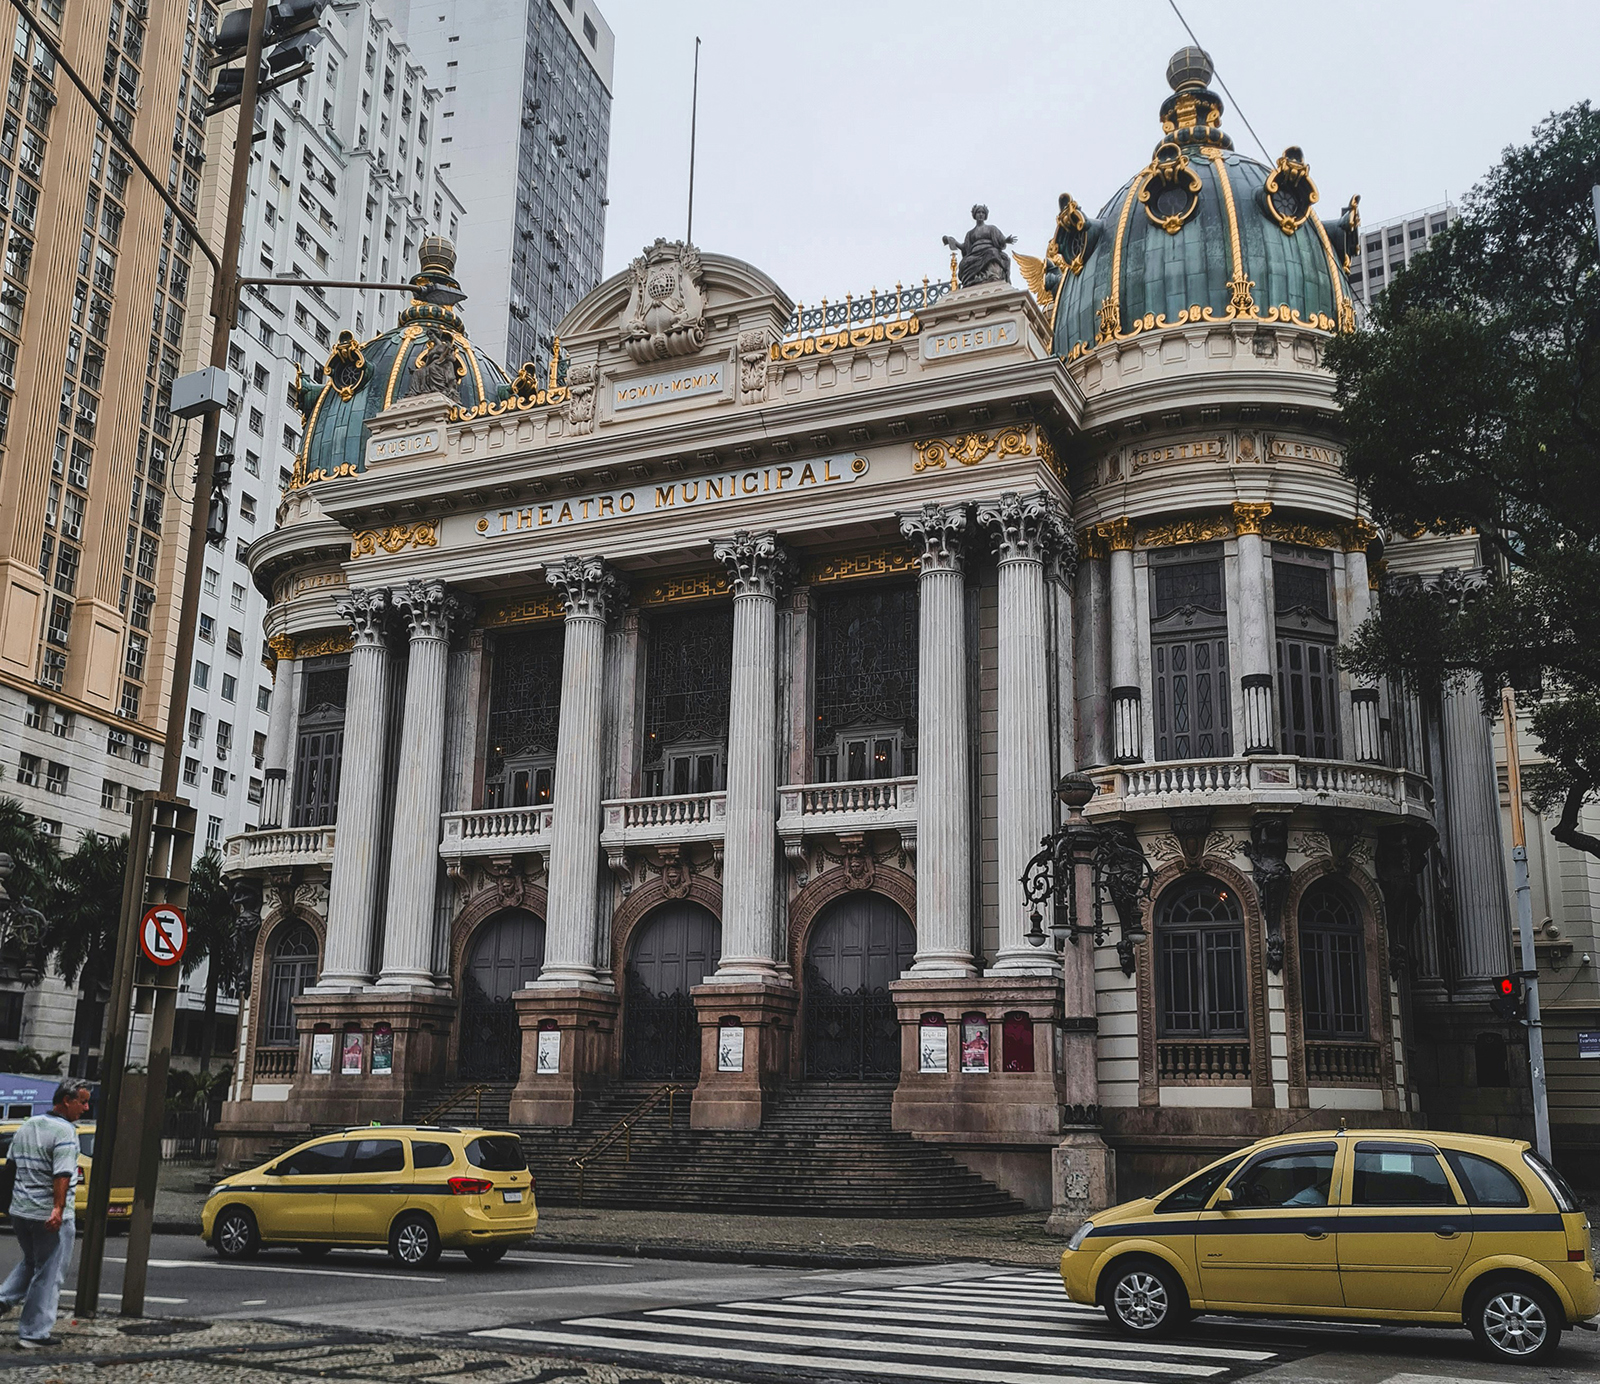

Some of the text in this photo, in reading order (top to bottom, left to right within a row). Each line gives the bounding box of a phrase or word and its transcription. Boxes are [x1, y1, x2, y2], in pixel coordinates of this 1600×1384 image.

[935, 327, 1008, 353] POESIA
[617, 371, 720, 403] MCMVI-MCMIX
[376, 436, 433, 457] MUSICA
[1140, 441, 1217, 465] GOETHE
[498, 459, 842, 533] THEATRO MUNICIPAL
